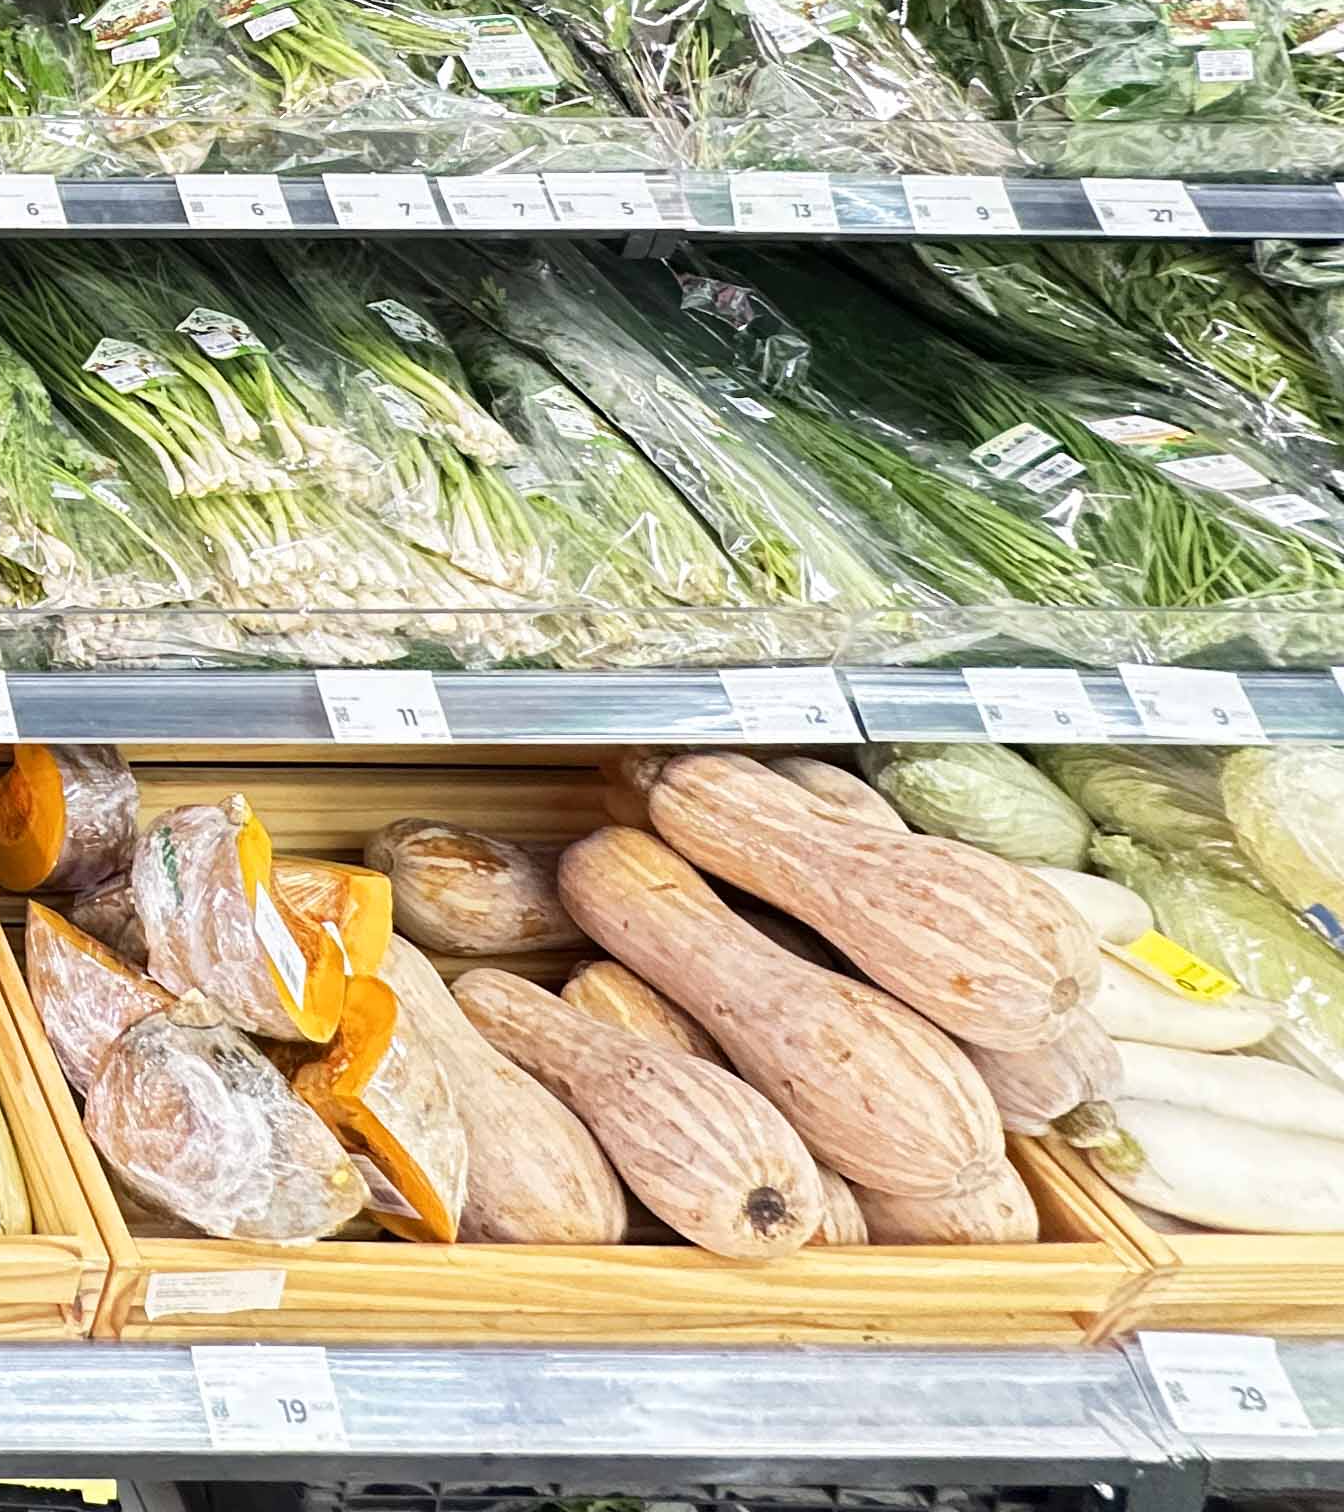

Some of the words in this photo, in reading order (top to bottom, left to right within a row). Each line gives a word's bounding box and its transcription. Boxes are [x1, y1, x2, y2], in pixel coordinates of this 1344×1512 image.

[26, 202, 40, 216] 6
[250, 202, 265, 217] 6
[397, 202, 411, 217] 7
[511, 202, 525, 217] 7
[620, 201, 635, 216] 5
[791, 203, 812, 218] 13
[975, 206, 990, 221] 9
[1148, 208, 1173, 223] 27
[396, 708, 419, 727] 11
[1211, 707, 1230, 726] 9
[1230, 1385, 1268, 1412] 29
[277, 1398, 308, 1424] 19
